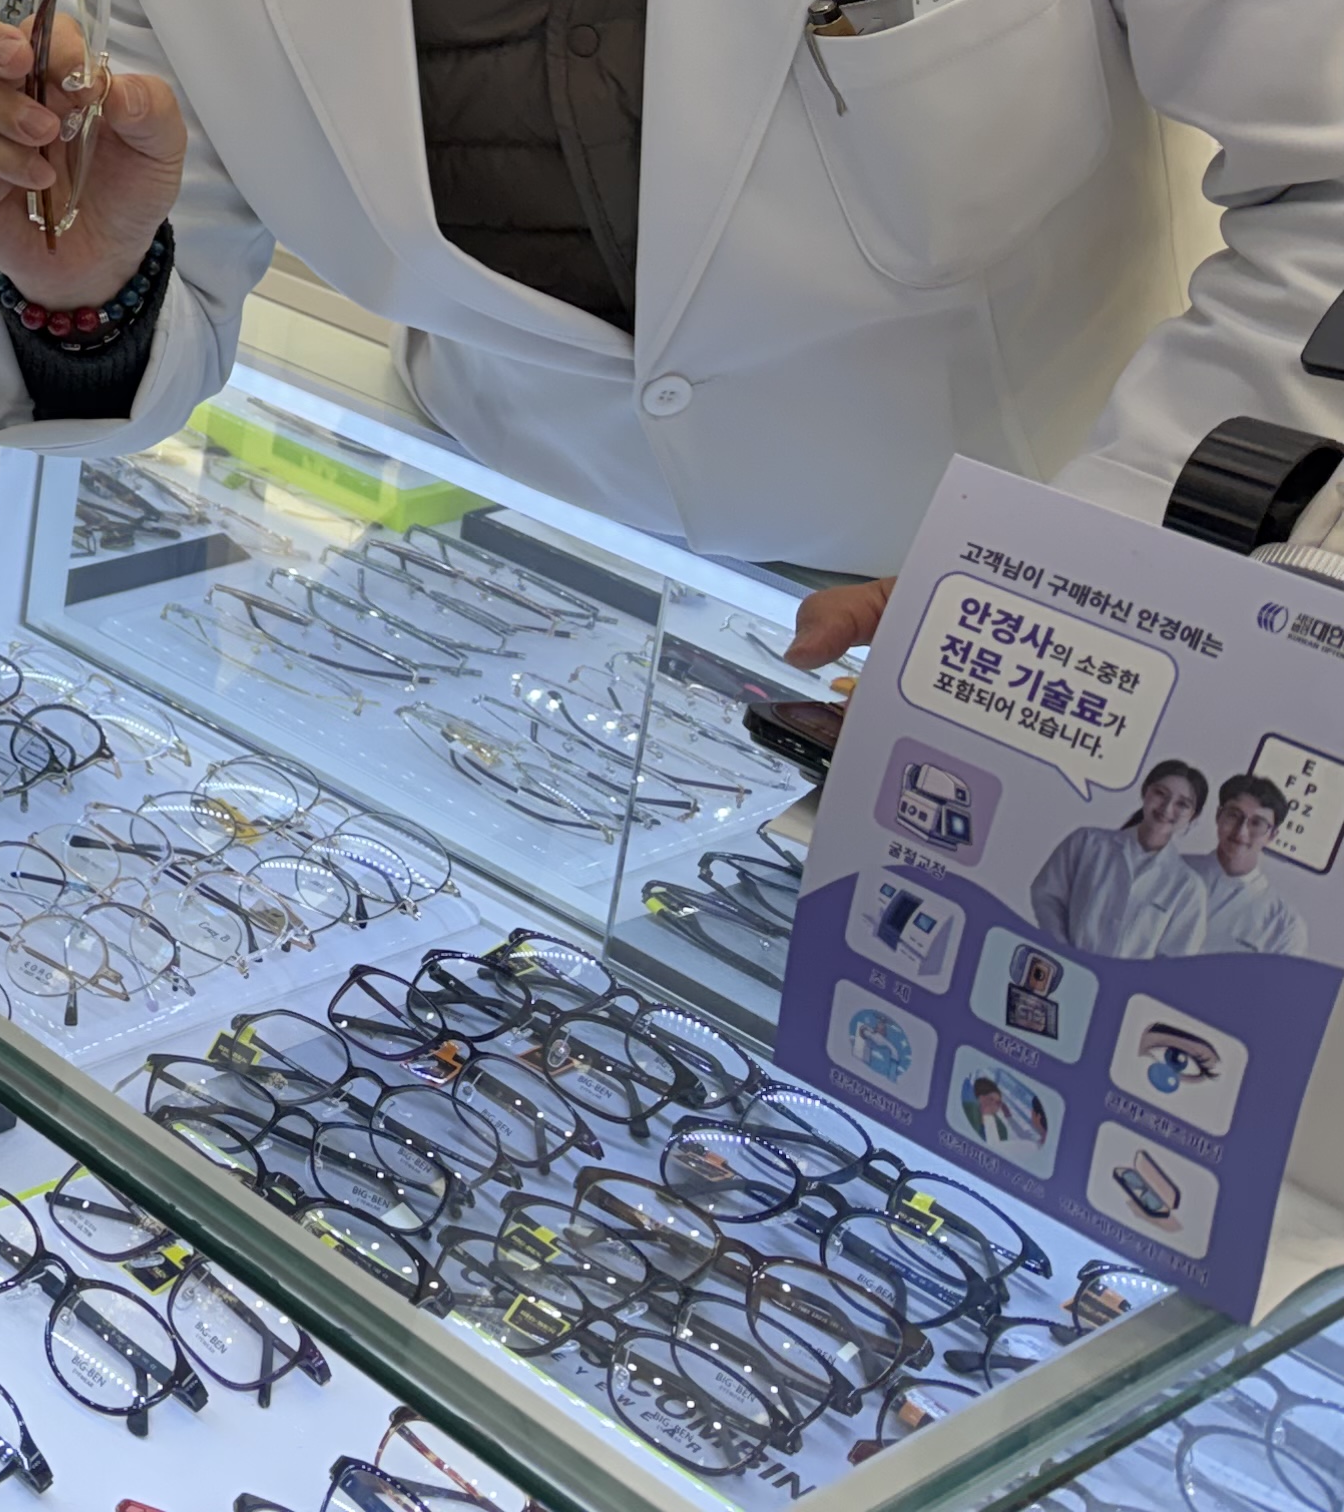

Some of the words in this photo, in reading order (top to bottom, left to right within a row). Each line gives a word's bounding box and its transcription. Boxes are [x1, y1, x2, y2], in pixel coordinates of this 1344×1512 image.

[959, 541, 1045, 590] 고객님이
[1046, 572, 1134, 625] 구매하신
[1136, 606, 1225, 659] 안경에는
[958, 596, 1074, 668] 안경사의
[1074, 654, 1142, 695] 소중한
[939, 633, 1003, 687] 전문
[1008, 662, 1128, 738] 기술료가
[932, 671, 1017, 723] 포함되어
[1018, 706, 1106, 761] 있습니다.
[1301, 759, 1317, 777] E
[1304, 783, 1317, 796] P
[889, 842, 947, 880] 굴절교정
[577, 1075, 613, 1100] BIG-BEN
[397, 1147, 432, 1174] BIG-BEN
[352, 1185, 391, 1209] BIG-BEN
[856, 1273, 897, 1305] BIG-BEN
[194, 1321, 227, 1354] BIG-BEN
[71, 1354, 107, 1389] BIG-BEN
[715, 1371, 756, 1403] BIG-BEN
